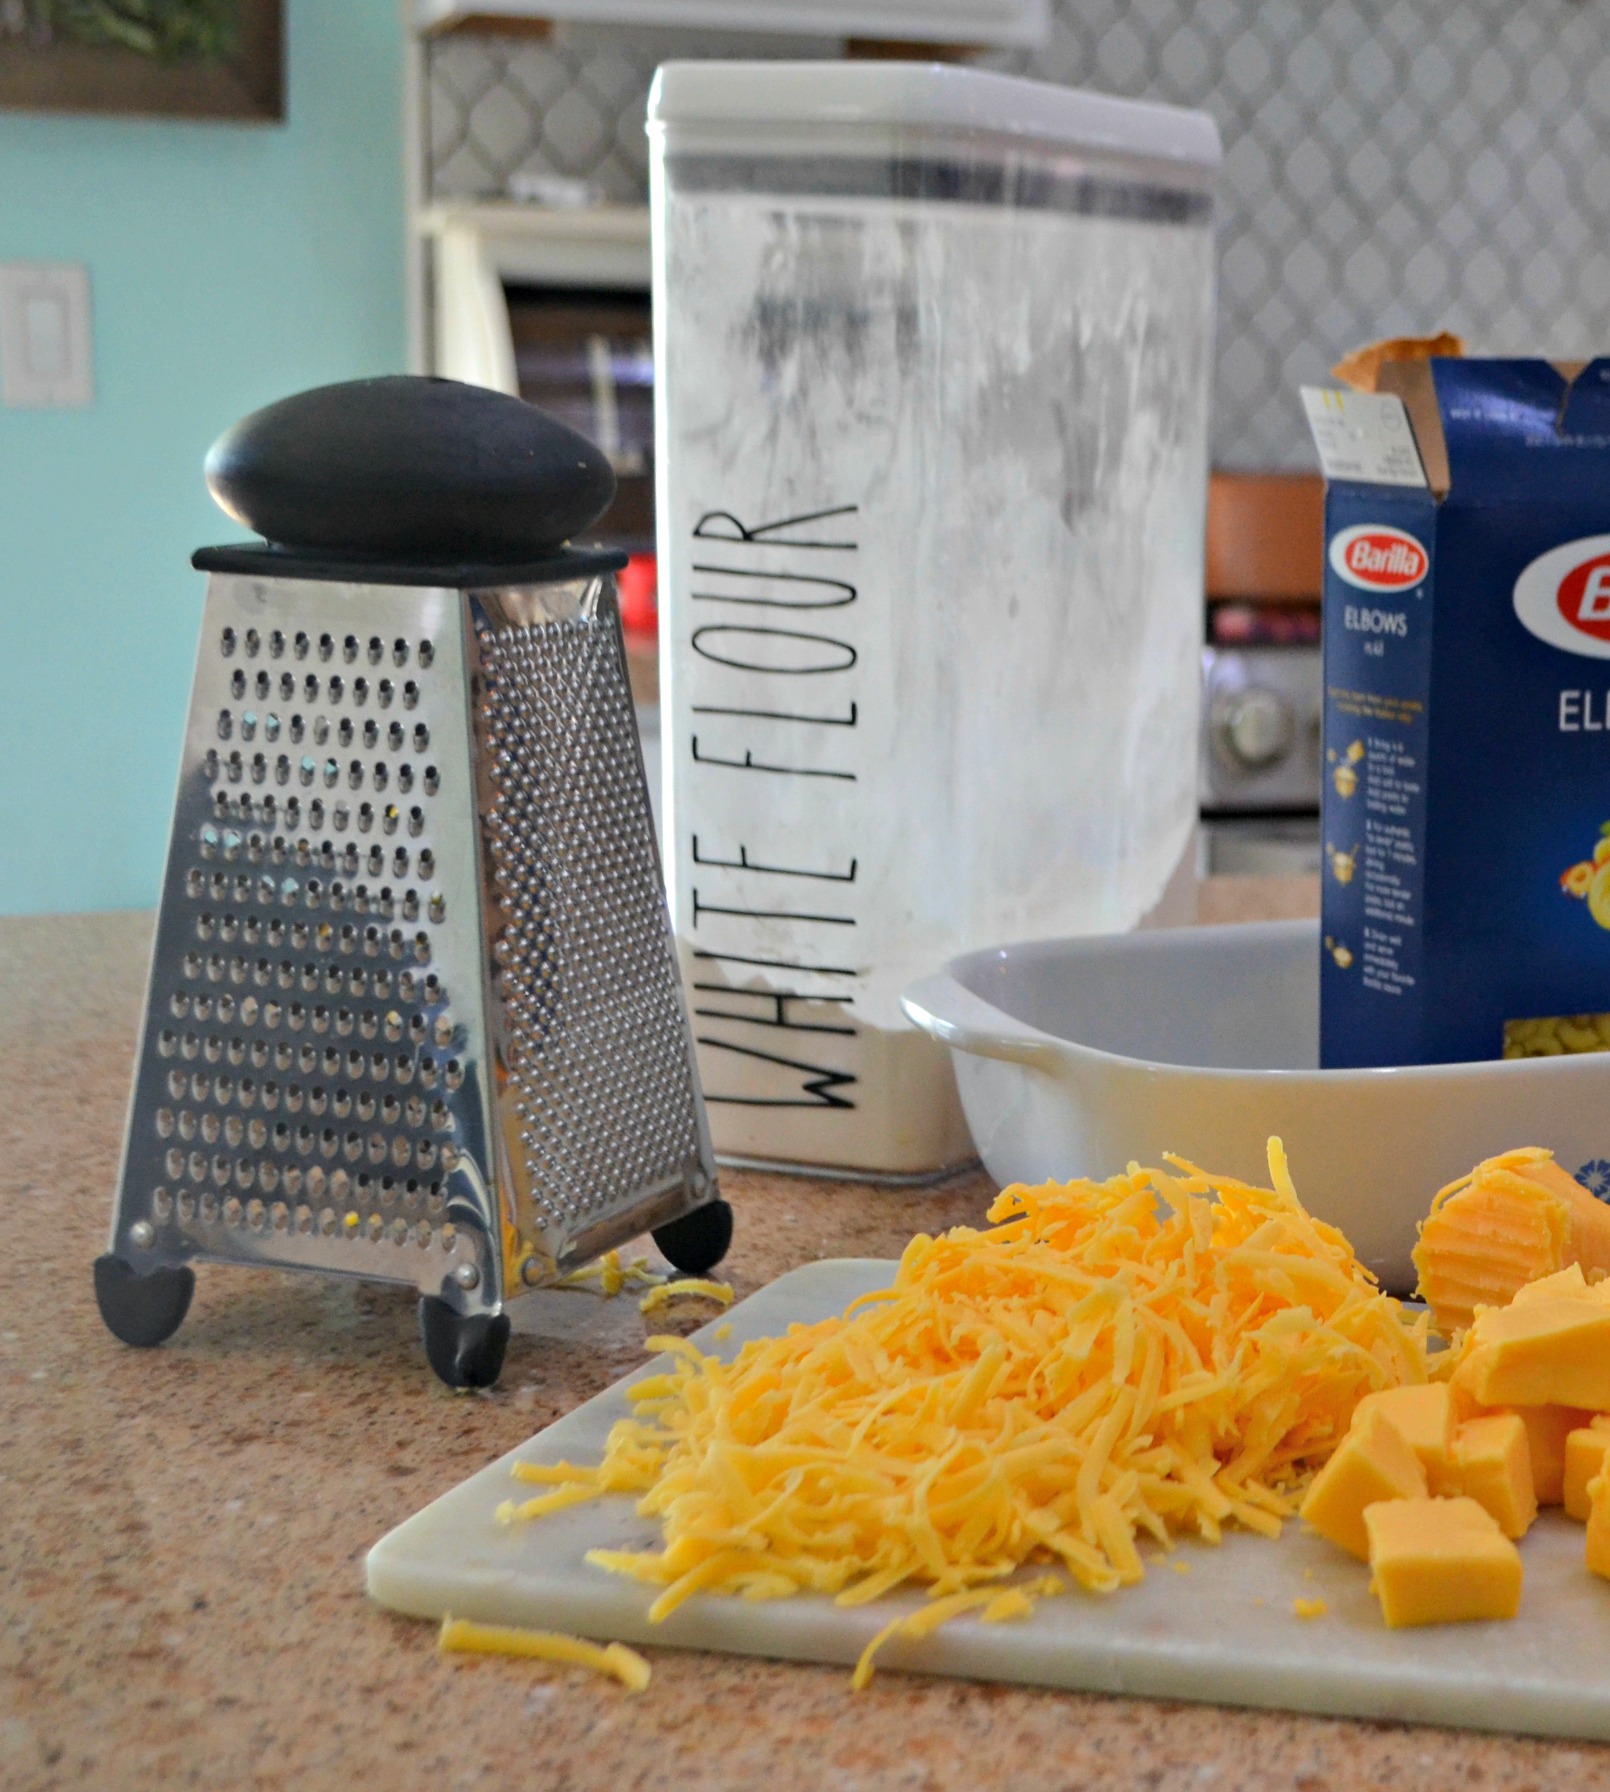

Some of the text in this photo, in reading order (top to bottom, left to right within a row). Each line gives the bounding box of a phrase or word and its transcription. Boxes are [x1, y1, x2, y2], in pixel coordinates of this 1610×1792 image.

[1351, 540, 1420, 577] Barilla
[1343, 604, 1408, 637] ELBOWS
[691, 505, 859, 1110] WHITE FLOUR
